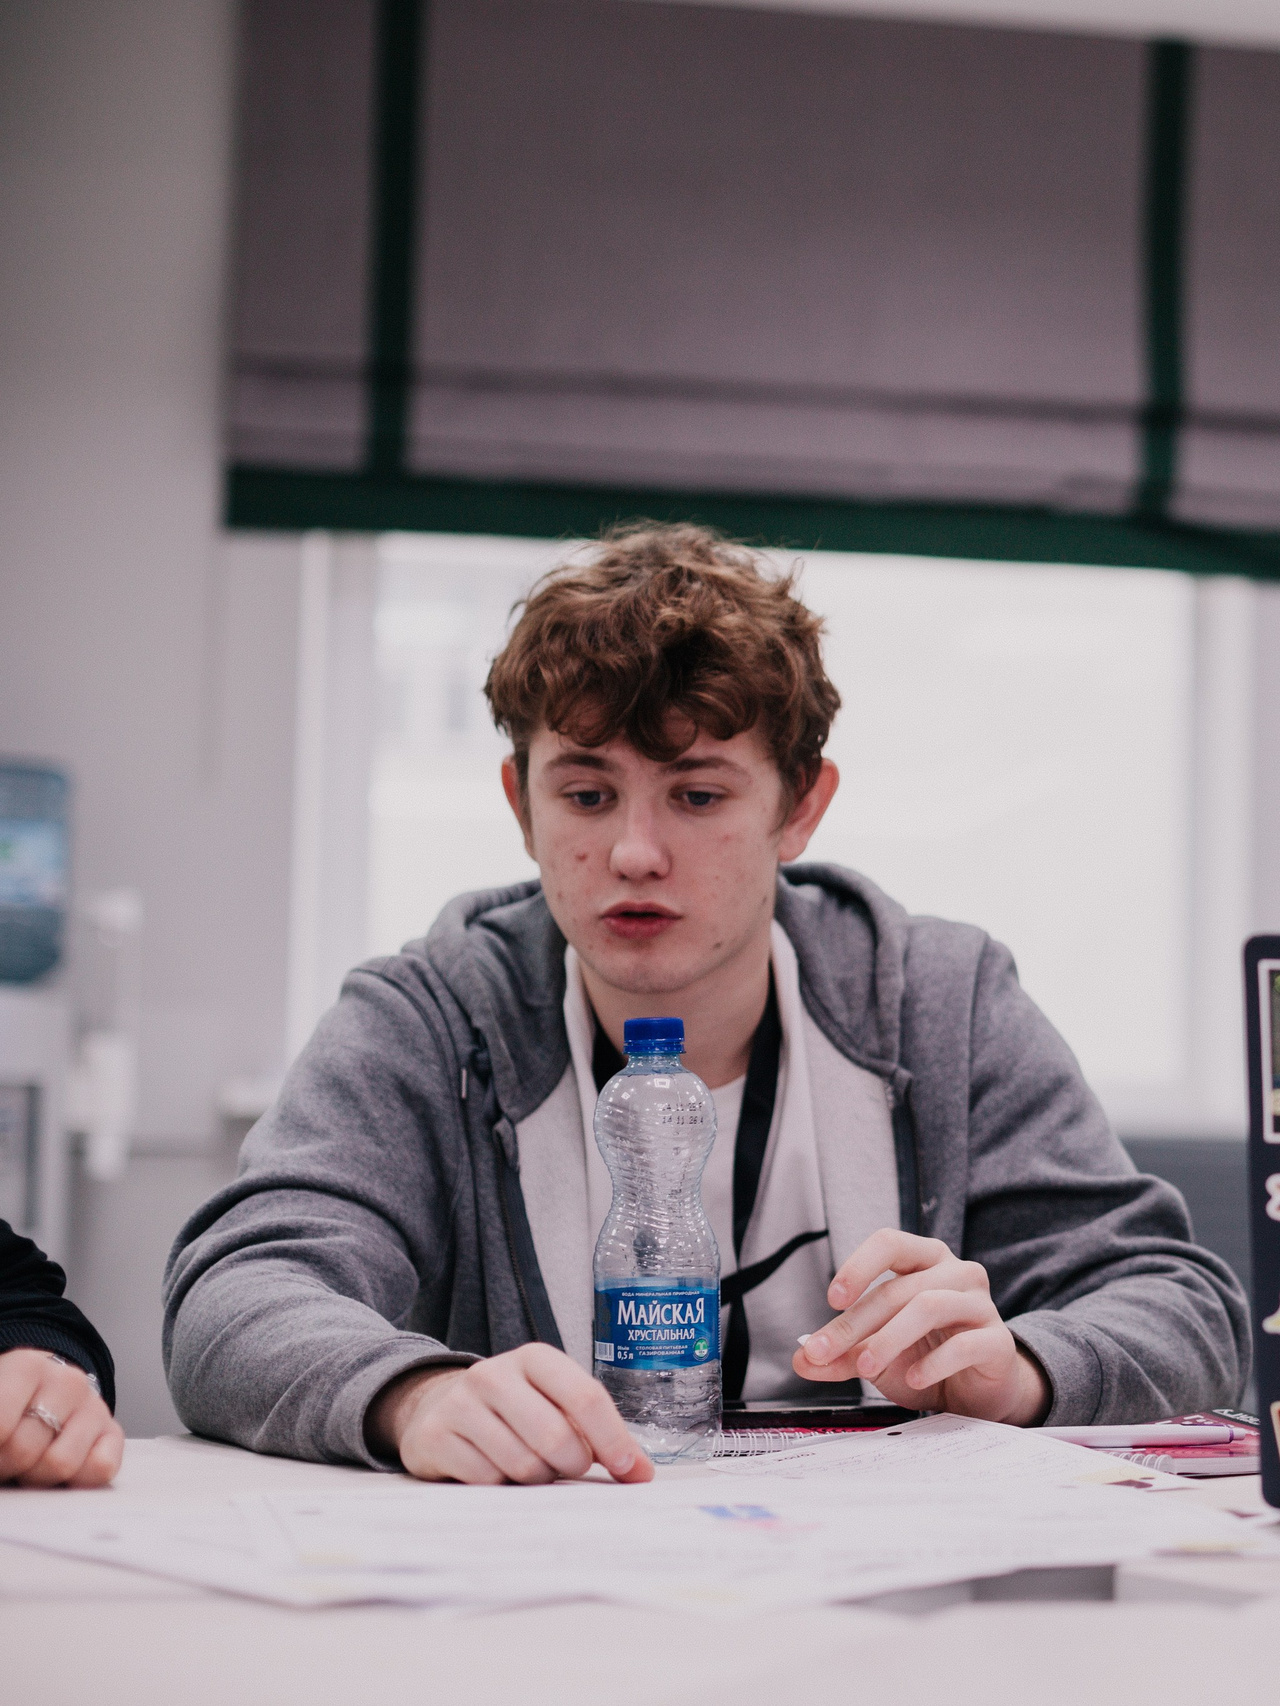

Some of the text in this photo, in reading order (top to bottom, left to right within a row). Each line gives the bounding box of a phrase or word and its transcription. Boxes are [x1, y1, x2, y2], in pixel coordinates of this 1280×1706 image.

[617, 1297, 705, 1326] МАЙСКАЯ
[627, 1328, 696, 1341] ХРУСТАЛЬНАЯ
[617, 1350, 628, 1360] 0,5
